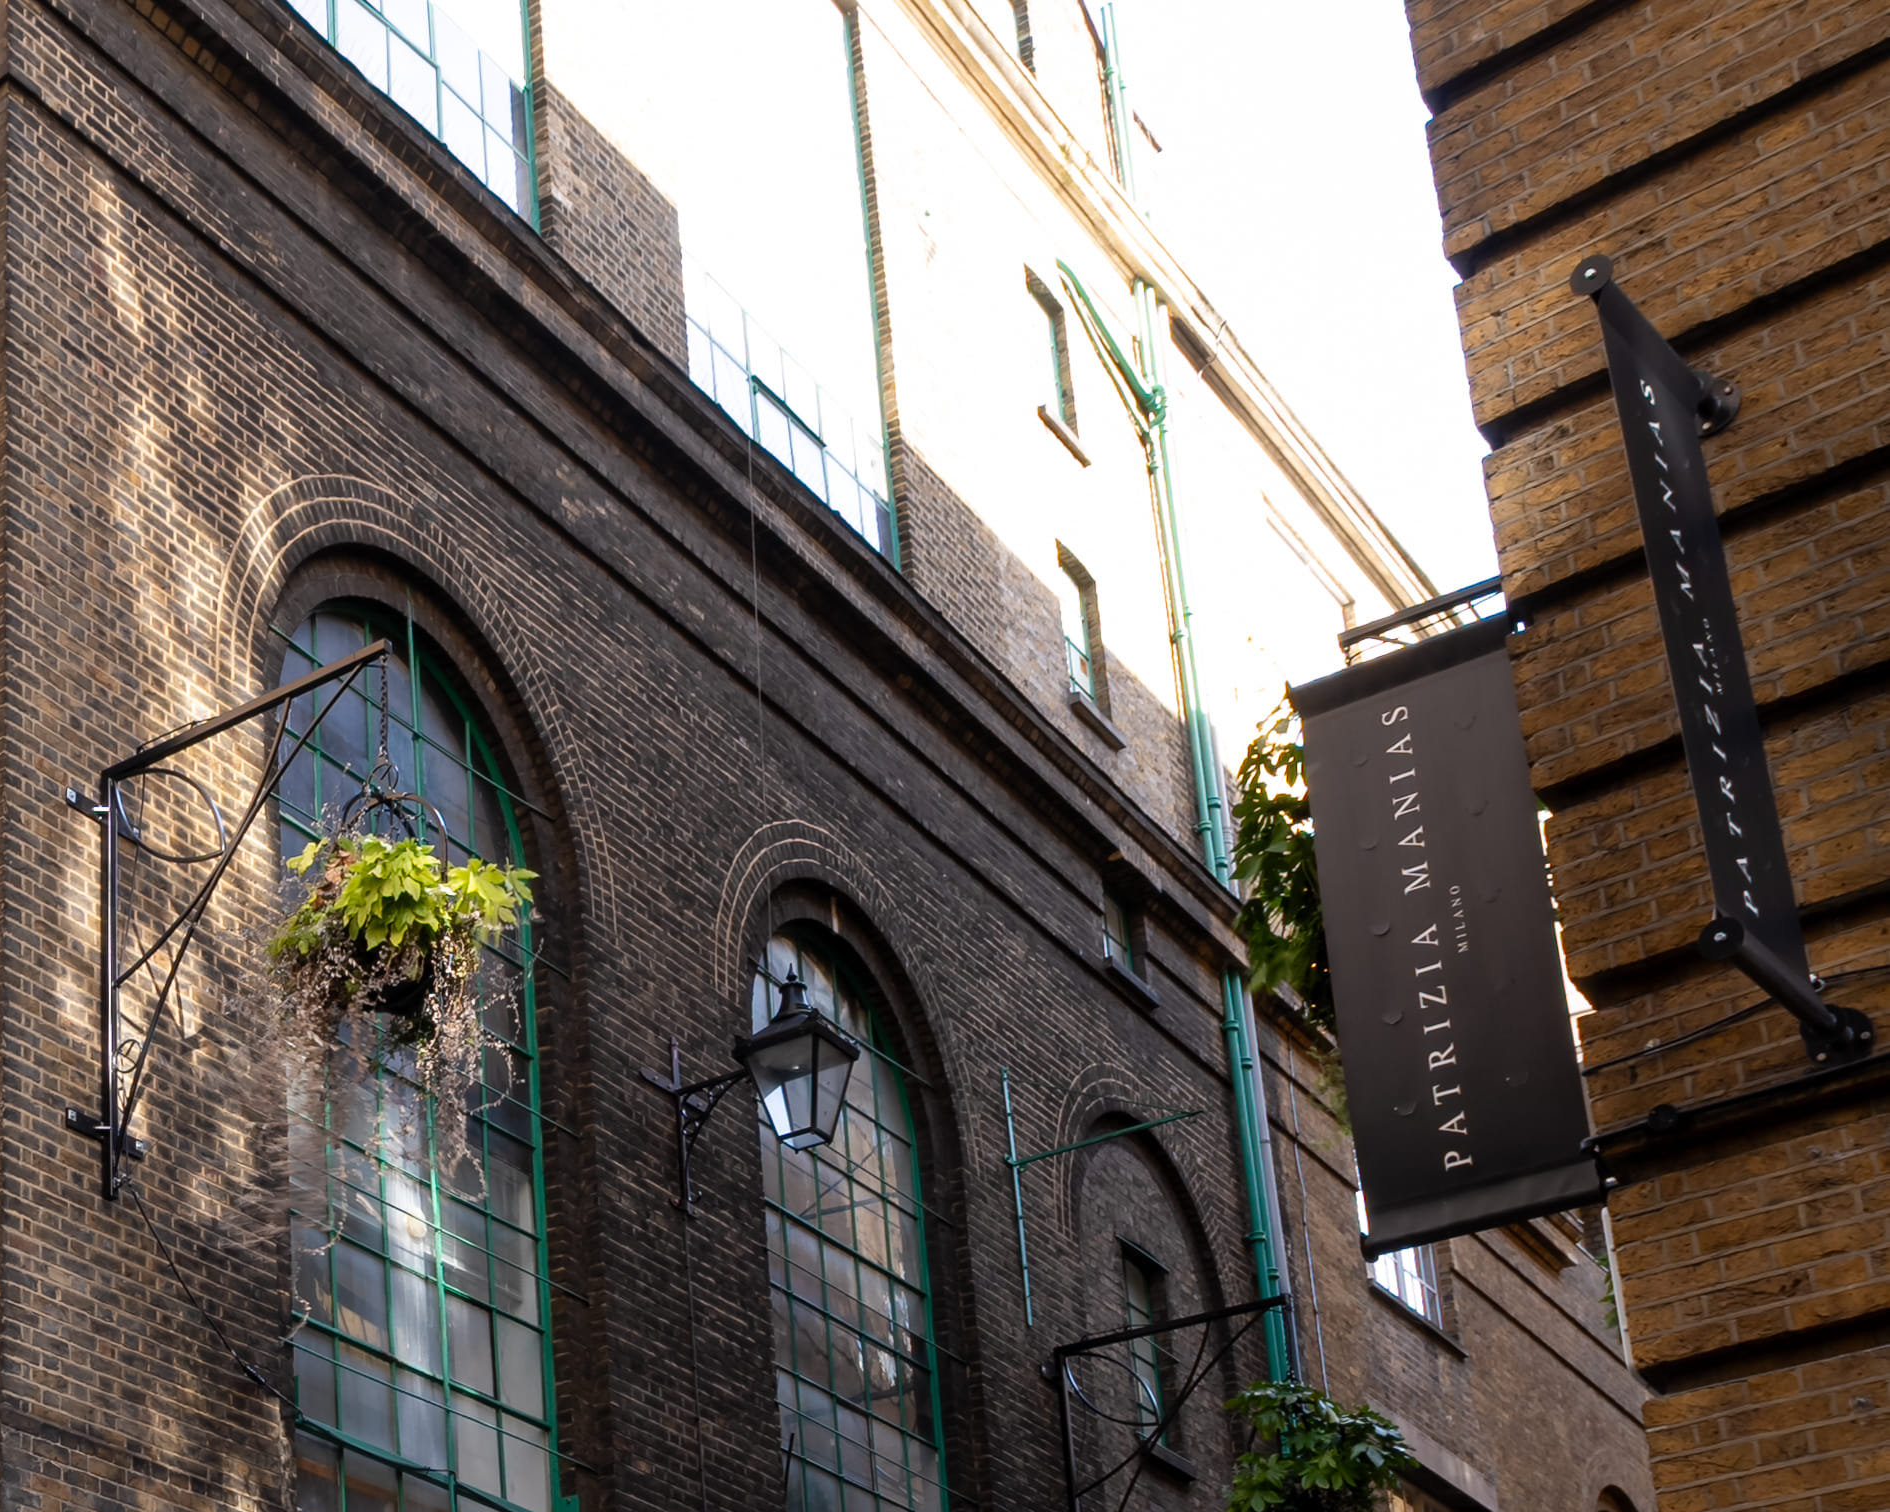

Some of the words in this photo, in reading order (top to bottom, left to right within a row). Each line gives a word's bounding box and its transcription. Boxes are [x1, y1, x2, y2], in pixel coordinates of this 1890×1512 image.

[1381, 705, 1431, 895] MANIAS
[1449, 885, 1469, 953] MILANO
[1411, 923, 1473, 1172] PATRIZIA
